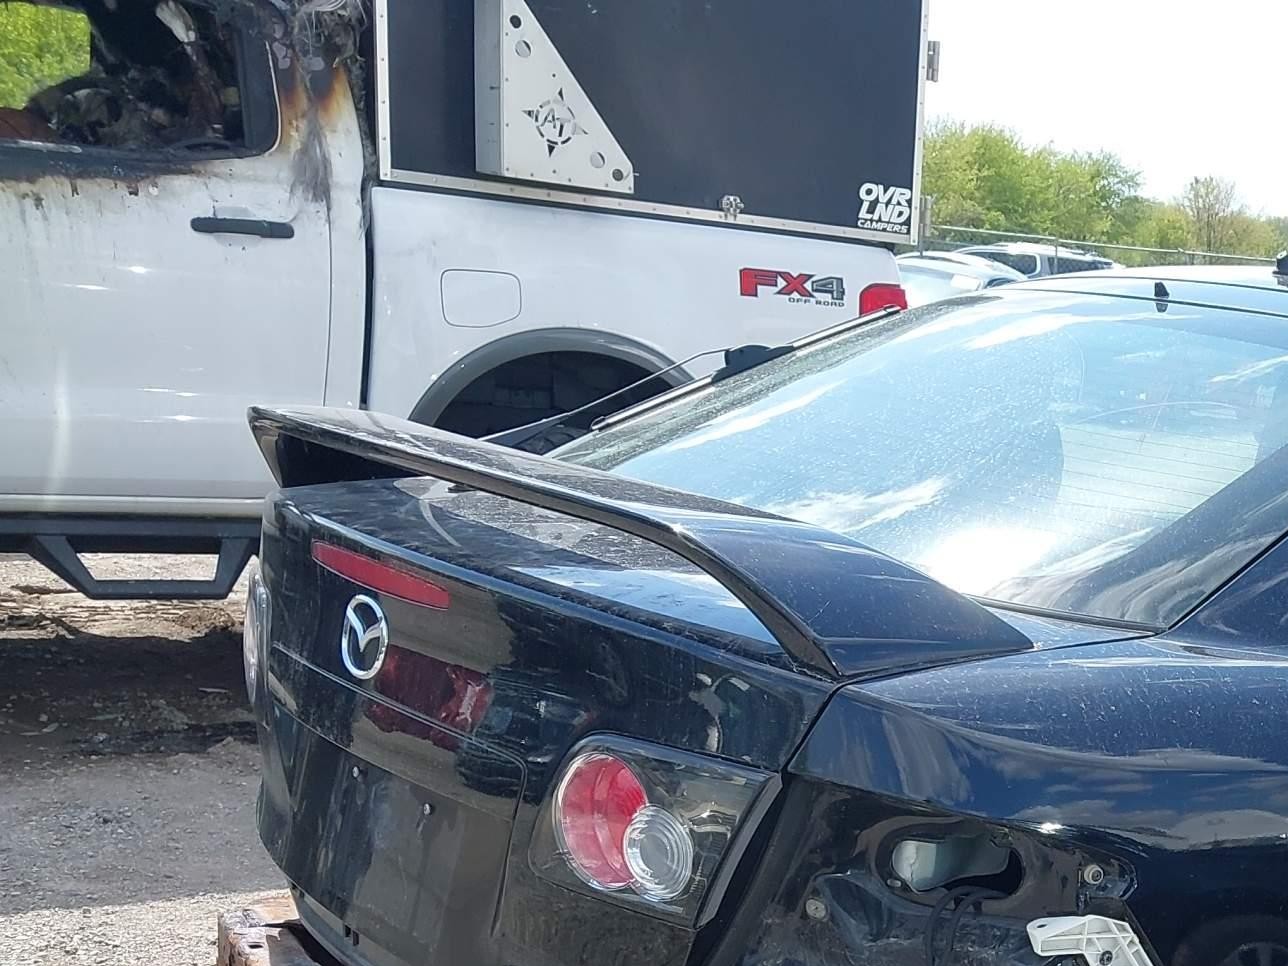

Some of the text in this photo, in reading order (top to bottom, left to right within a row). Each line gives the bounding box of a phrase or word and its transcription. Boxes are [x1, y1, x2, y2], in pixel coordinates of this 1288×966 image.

[859, 183, 911, 206] OVR
[858, 200, 910, 223] LND
[858, 219, 909, 233] CAMPERS
[739, 268, 845, 301] FX4
